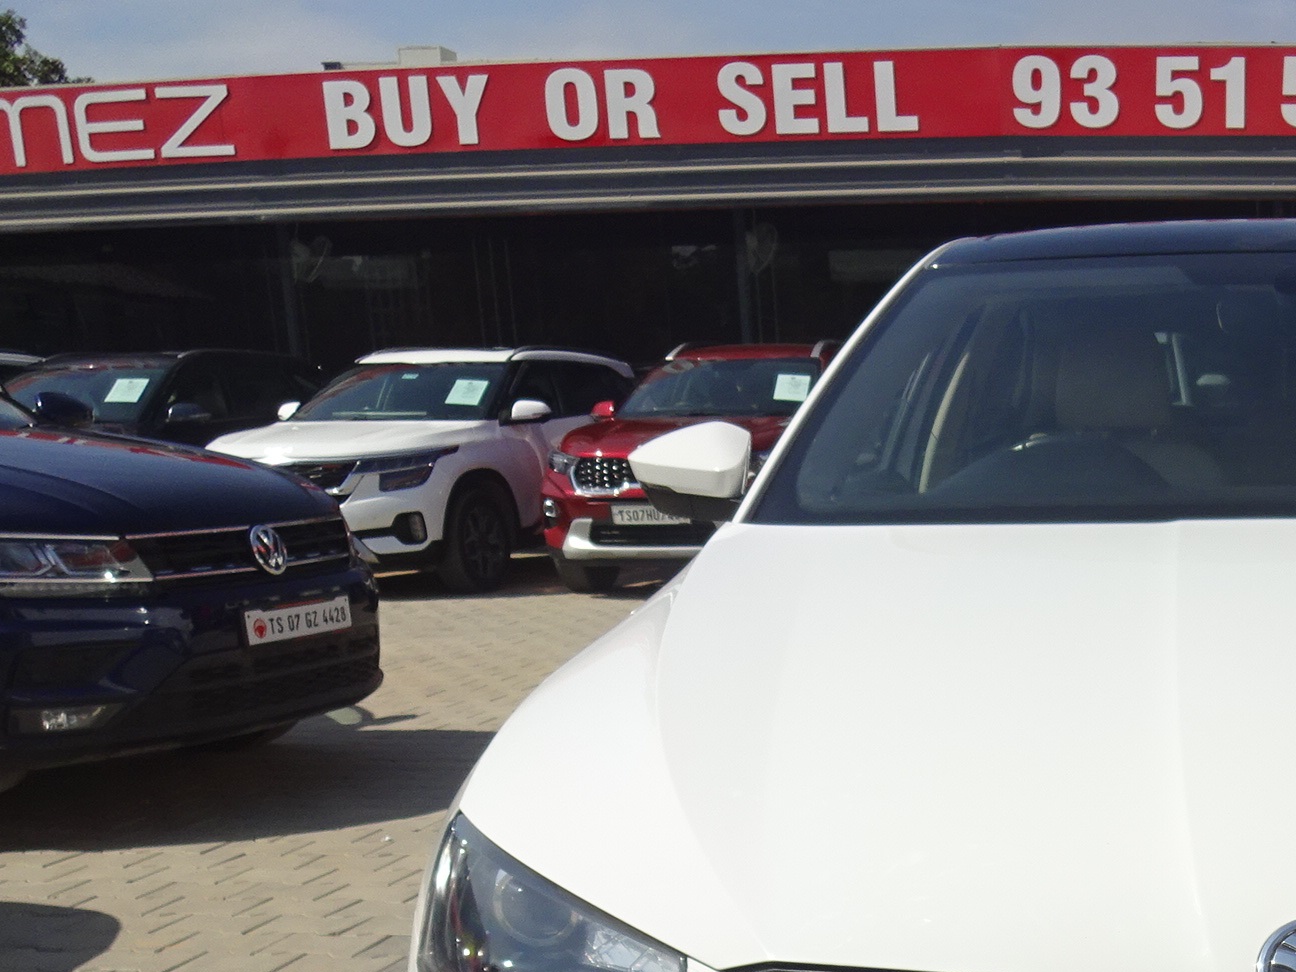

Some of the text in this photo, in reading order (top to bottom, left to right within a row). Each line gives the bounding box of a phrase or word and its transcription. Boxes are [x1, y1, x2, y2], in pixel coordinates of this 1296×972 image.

[322, 75, 490, 150] BUY
[545, 68, 661, 141] OR
[717, 61, 919, 136] SELL
[1012, 55, 1120, 128] 93
[1155, 56, 1246, 129] 51
[268, 606, 347, 634] TS 07 GZ 4428
